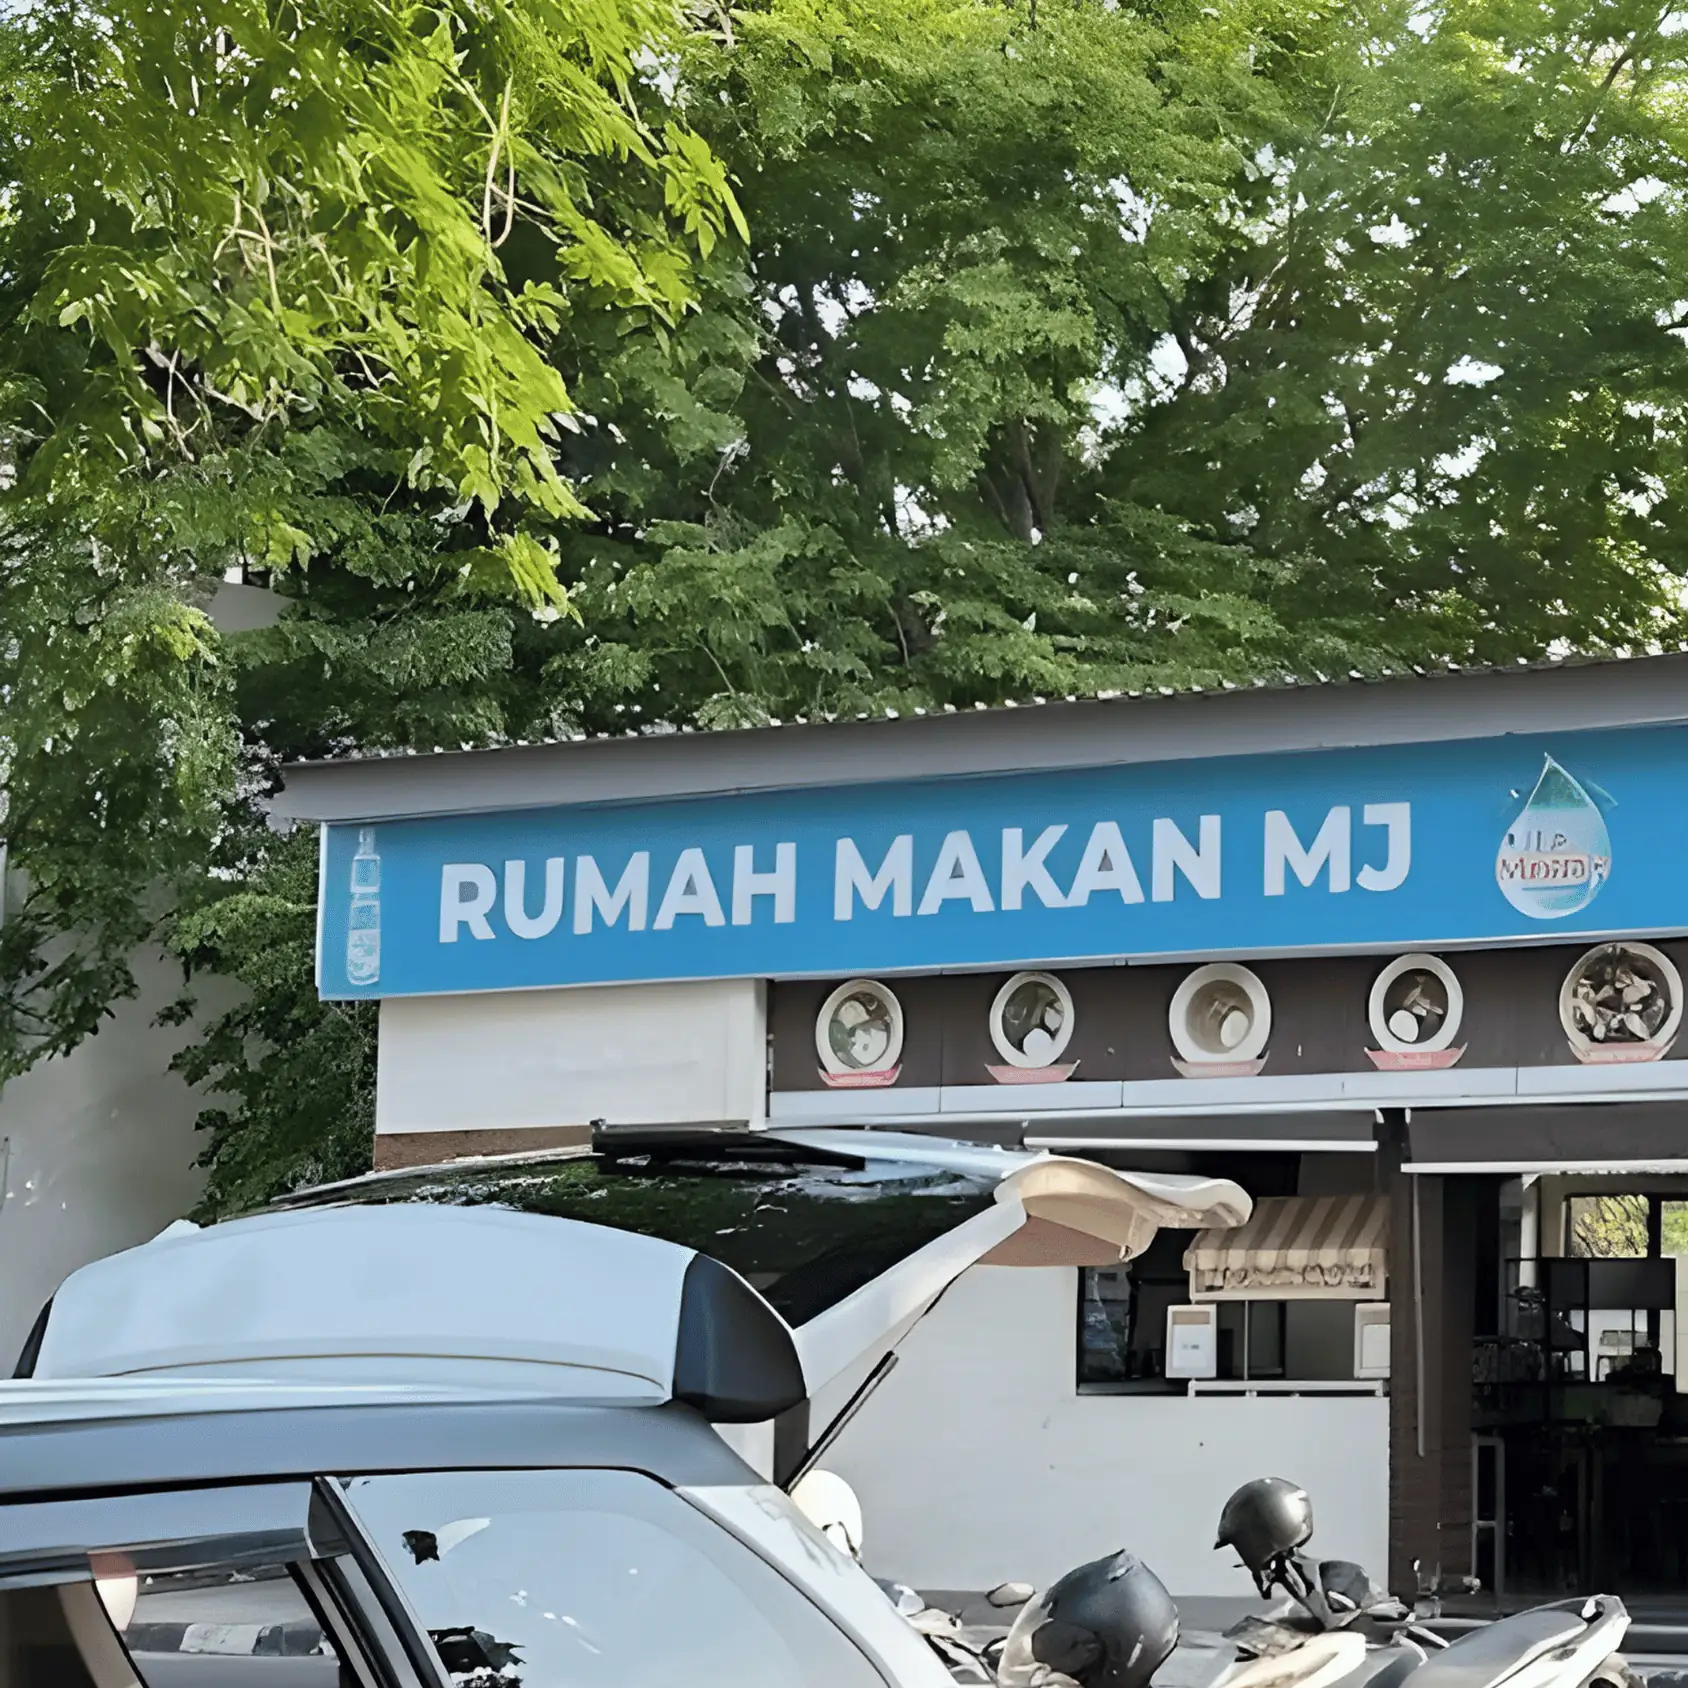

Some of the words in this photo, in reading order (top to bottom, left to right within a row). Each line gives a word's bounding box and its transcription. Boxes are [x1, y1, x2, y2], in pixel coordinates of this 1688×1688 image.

[439, 842, 796, 943] RUMAH
[833, 815, 1223, 921] MAKAN
[1263, 802, 1411, 896] MJ
